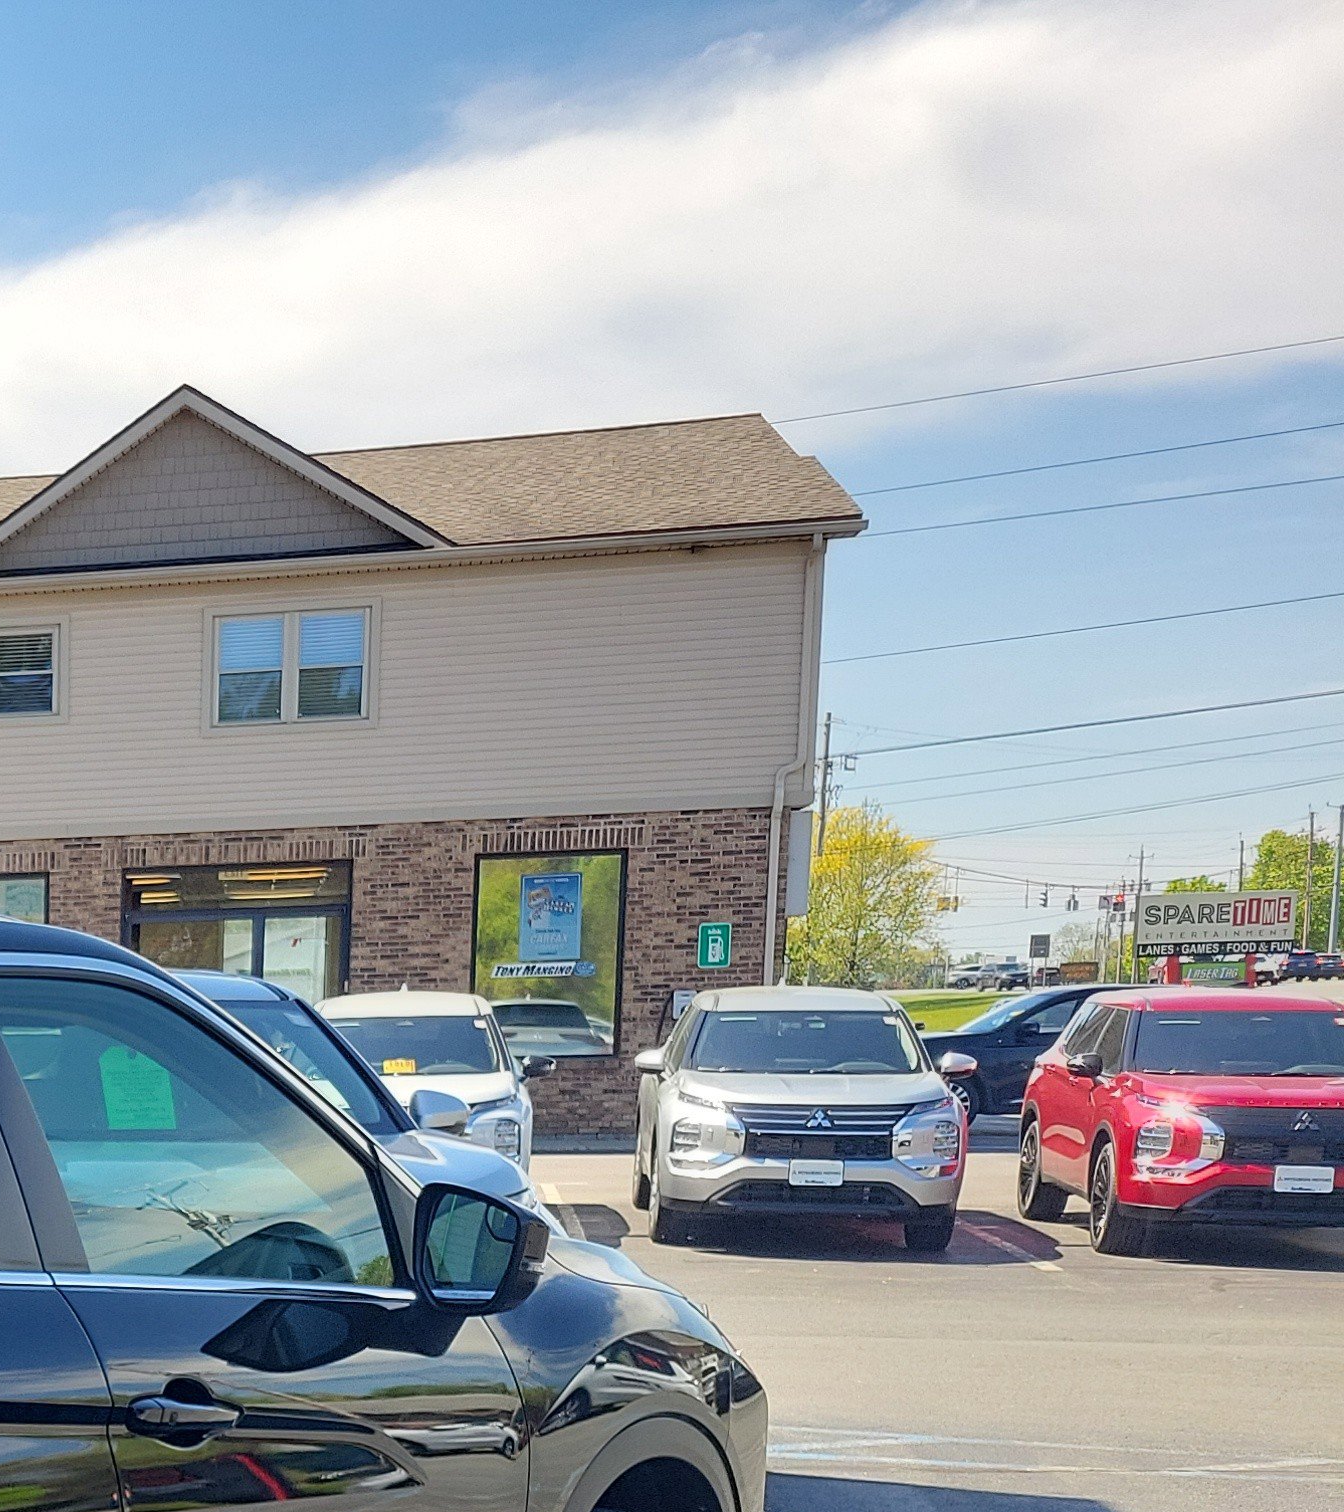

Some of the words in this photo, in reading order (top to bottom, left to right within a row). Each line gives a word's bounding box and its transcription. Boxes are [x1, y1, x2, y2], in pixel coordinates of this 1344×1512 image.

[1145, 928, 1289, 940] ENTERTAINMENT
[1138, 944, 1174, 956] LANES
[1181, 943, 1220, 955] GAMES
[1226, 942, 1257, 953] FOOD
[1258, 942, 1268, 953] &
[1269, 941, 1293, 952] FUN
